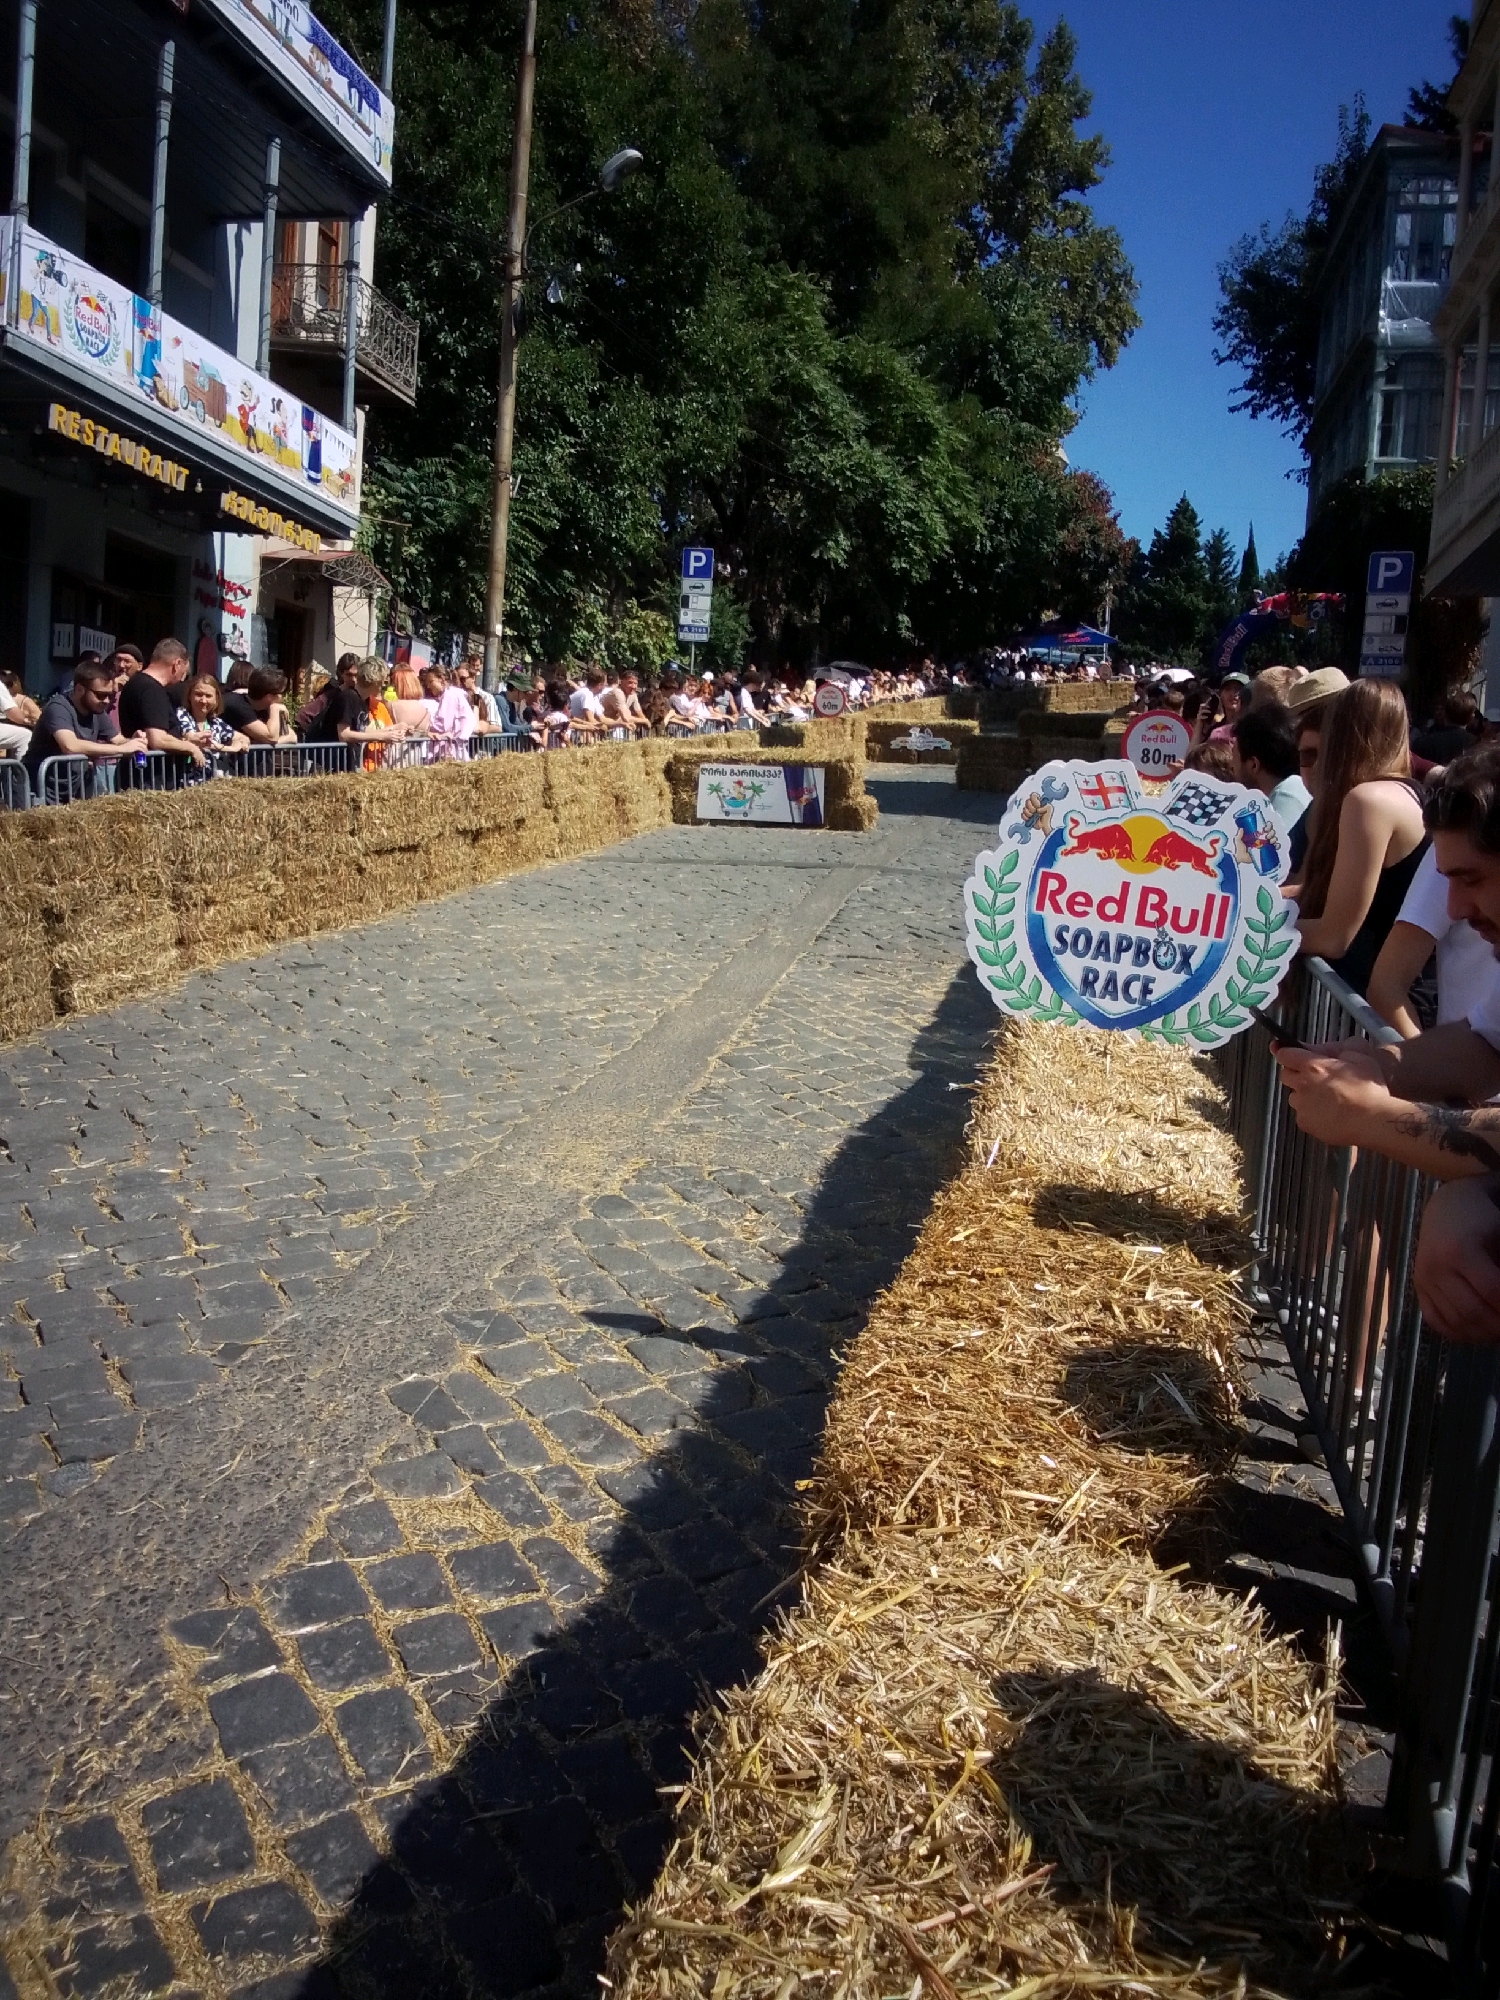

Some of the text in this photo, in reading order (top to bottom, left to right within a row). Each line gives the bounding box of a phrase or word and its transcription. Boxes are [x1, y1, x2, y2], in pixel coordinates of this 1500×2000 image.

[74, 306, 111, 336] Red Bull
[48, 403, 190, 491] RESTAURANT
[688, 550, 707, 576] P
[1376, 557, 1404, 589] P
[822, 701, 839, 711] 60m
[1141, 734, 1177, 744] Red Bull
[1140, 747, 1177, 765] 80m
[700, 767, 728, 777] ღირს
[1034, 870, 1231, 940] Red Bull
[1052, 922, 1199, 977] SOAPBOX
[1078, 965, 1157, 1007] RACE
